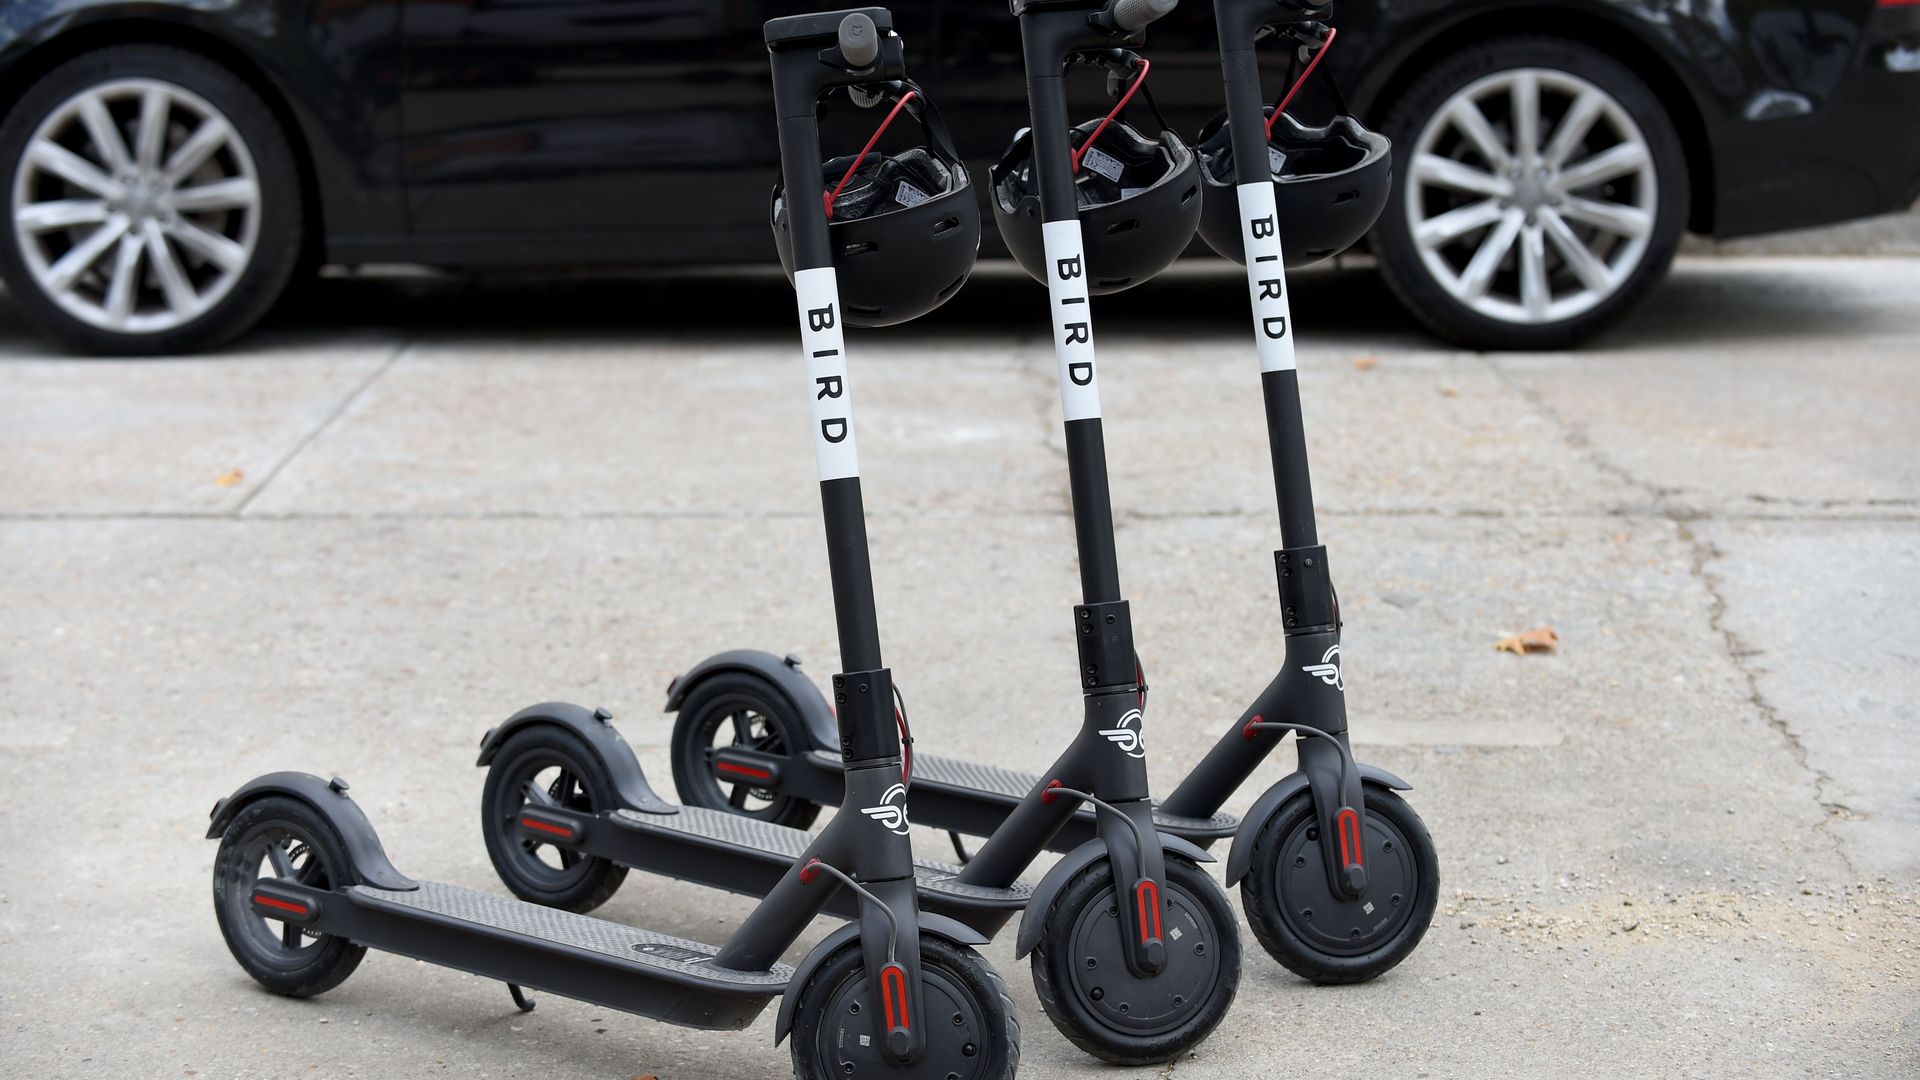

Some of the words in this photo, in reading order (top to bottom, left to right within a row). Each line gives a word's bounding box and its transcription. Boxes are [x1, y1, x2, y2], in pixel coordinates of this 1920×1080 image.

[1056, 253, 1093, 387] BIRD
[1250, 213, 1287, 340] BIRD
[807, 302, 848, 444] BIRD
